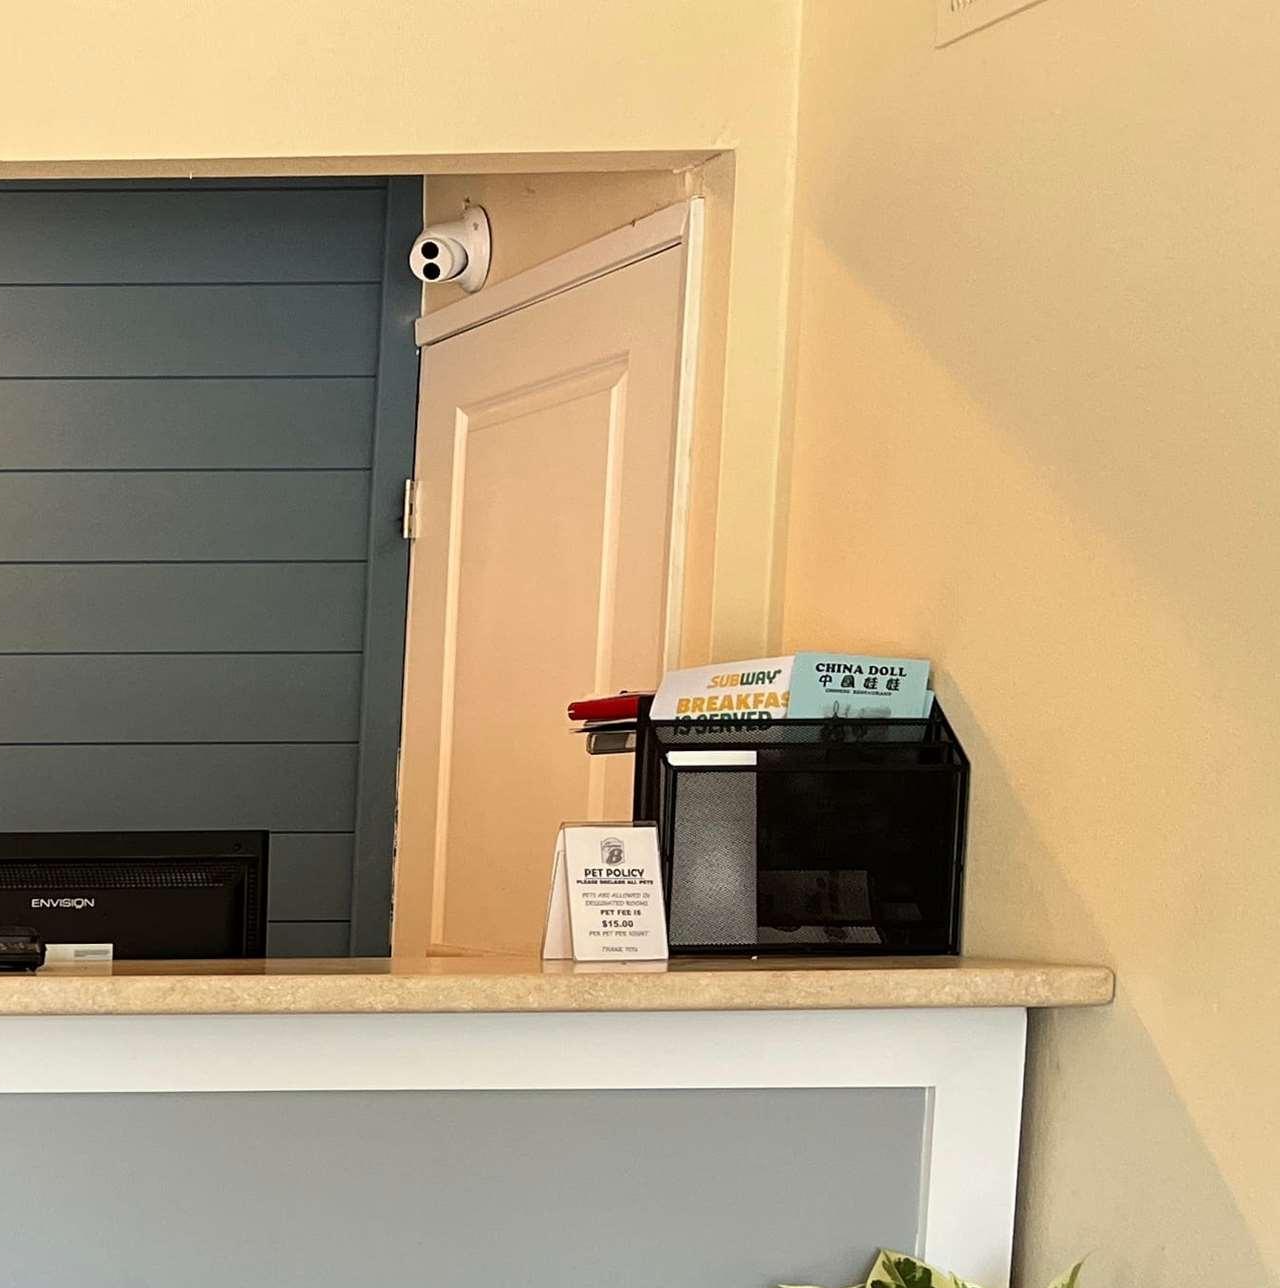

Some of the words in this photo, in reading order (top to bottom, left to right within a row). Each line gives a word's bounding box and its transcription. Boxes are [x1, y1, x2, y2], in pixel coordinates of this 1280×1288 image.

[815, 663, 864, 674] CHINA
[868, 665, 907, 677] DOLL
[707, 669, 782, 688] SUBWAY
[584, 869, 604, 877] PET
[606, 868, 645, 877] POLICY
[31, 898, 95, 909] ENVISION
[601, 920, 634, 928] $15.00
